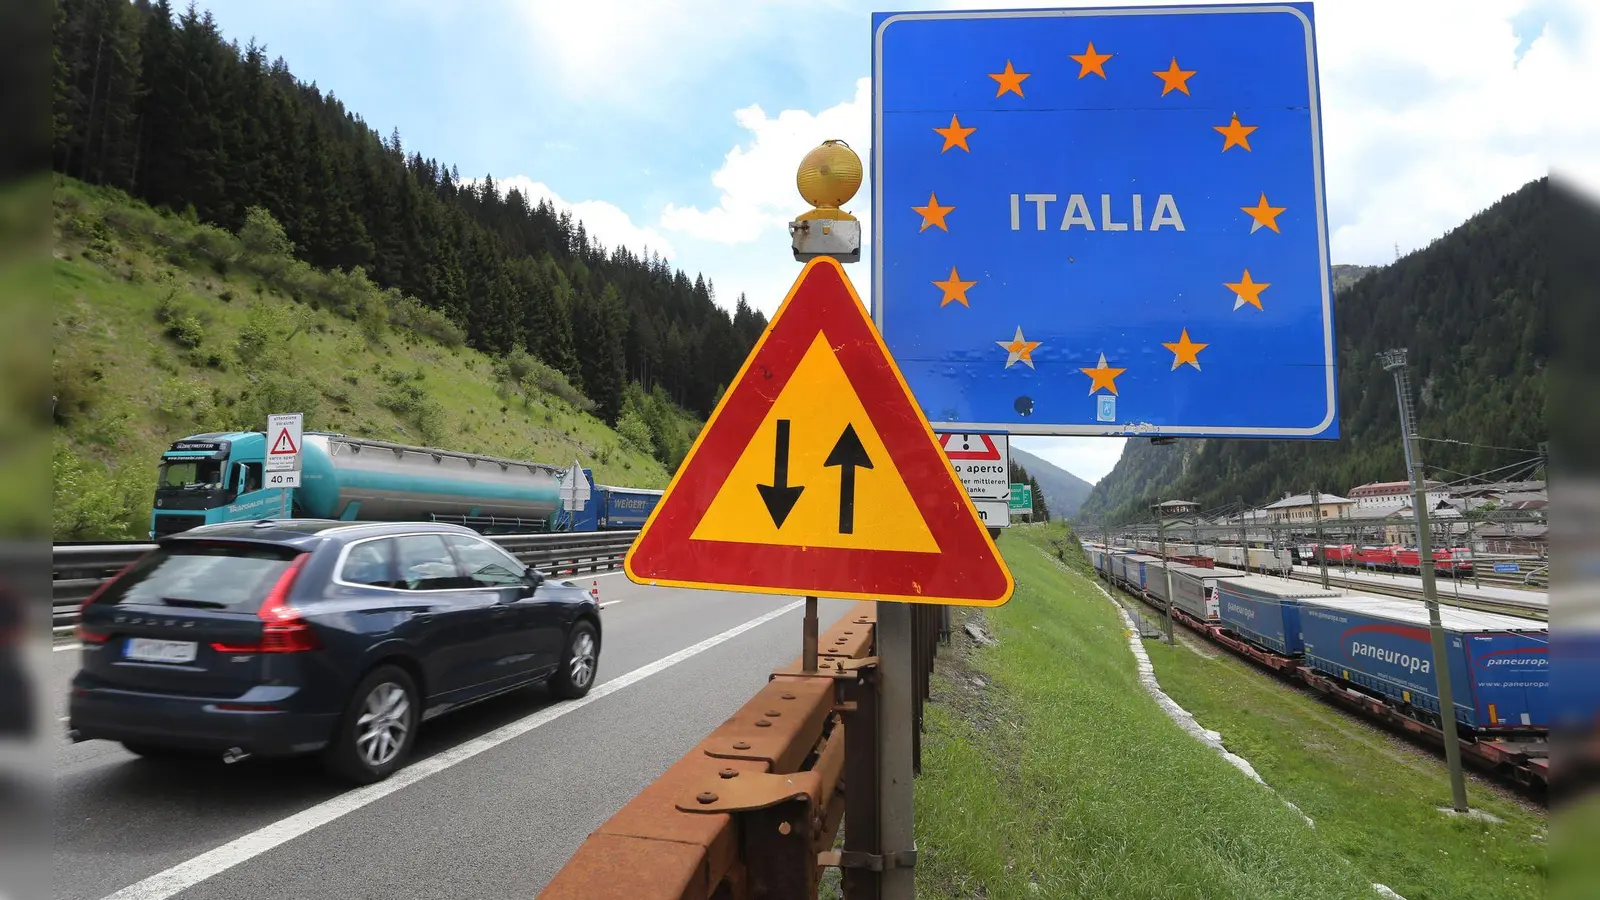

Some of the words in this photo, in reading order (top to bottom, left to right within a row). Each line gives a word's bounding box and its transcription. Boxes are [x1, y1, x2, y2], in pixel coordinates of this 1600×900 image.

[1010, 194, 1186, 232] ITALIA
[966, 465, 1004, 474] aperto
[271, 475, 283, 484] 40
[1227, 602, 1255, 620] paneuropa
[1352, 641, 1430, 674] paneuropa
[1487, 658, 1548, 667] paneurop
